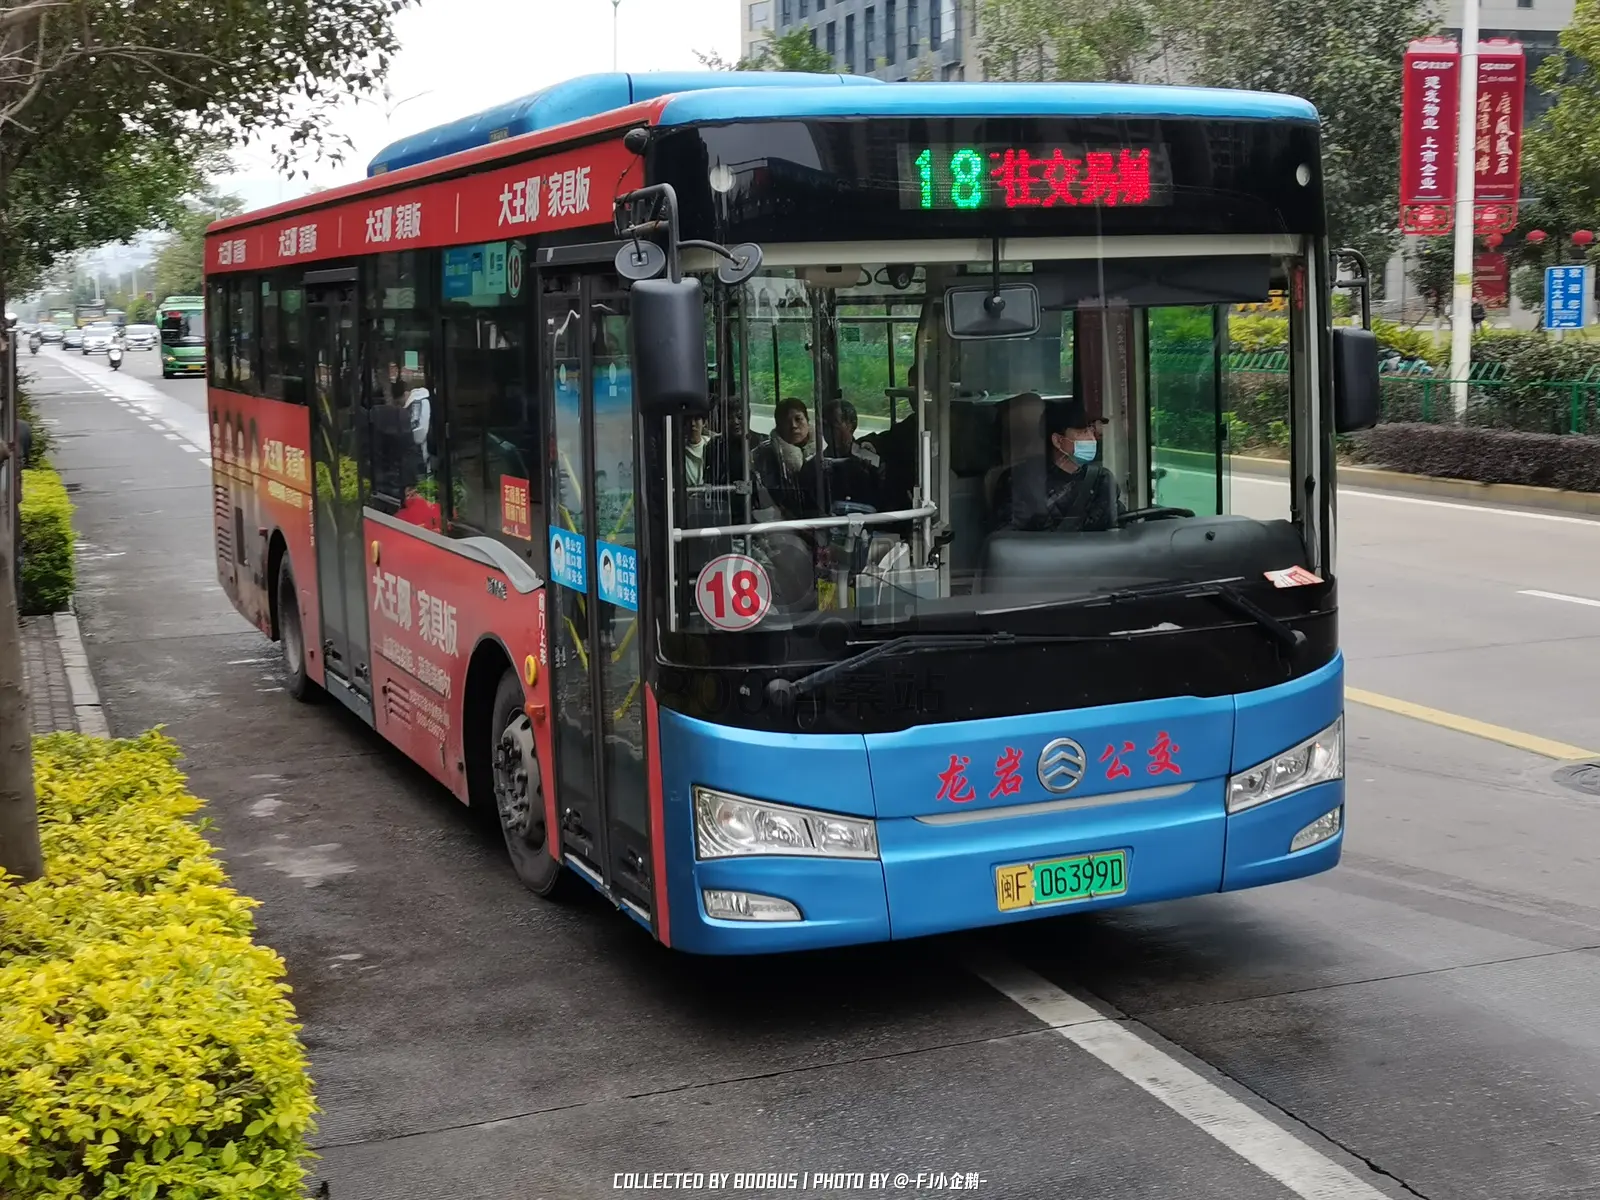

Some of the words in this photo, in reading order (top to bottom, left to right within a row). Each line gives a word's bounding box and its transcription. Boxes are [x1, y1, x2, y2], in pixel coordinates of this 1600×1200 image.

[914, 147, 983, 209] 18
[1418, 136, 1439, 189] 上市企业
[547, 165, 591, 217] 家具板
[508, 254, 520, 290] 18
[616, 584, 637, 604] 保安全
[705, 569, 761, 618] 18
[417, 589, 459, 658] 家具板
[936, 746, 1024, 803] 龙岩
[1097, 731, 1182, 780] 公交
